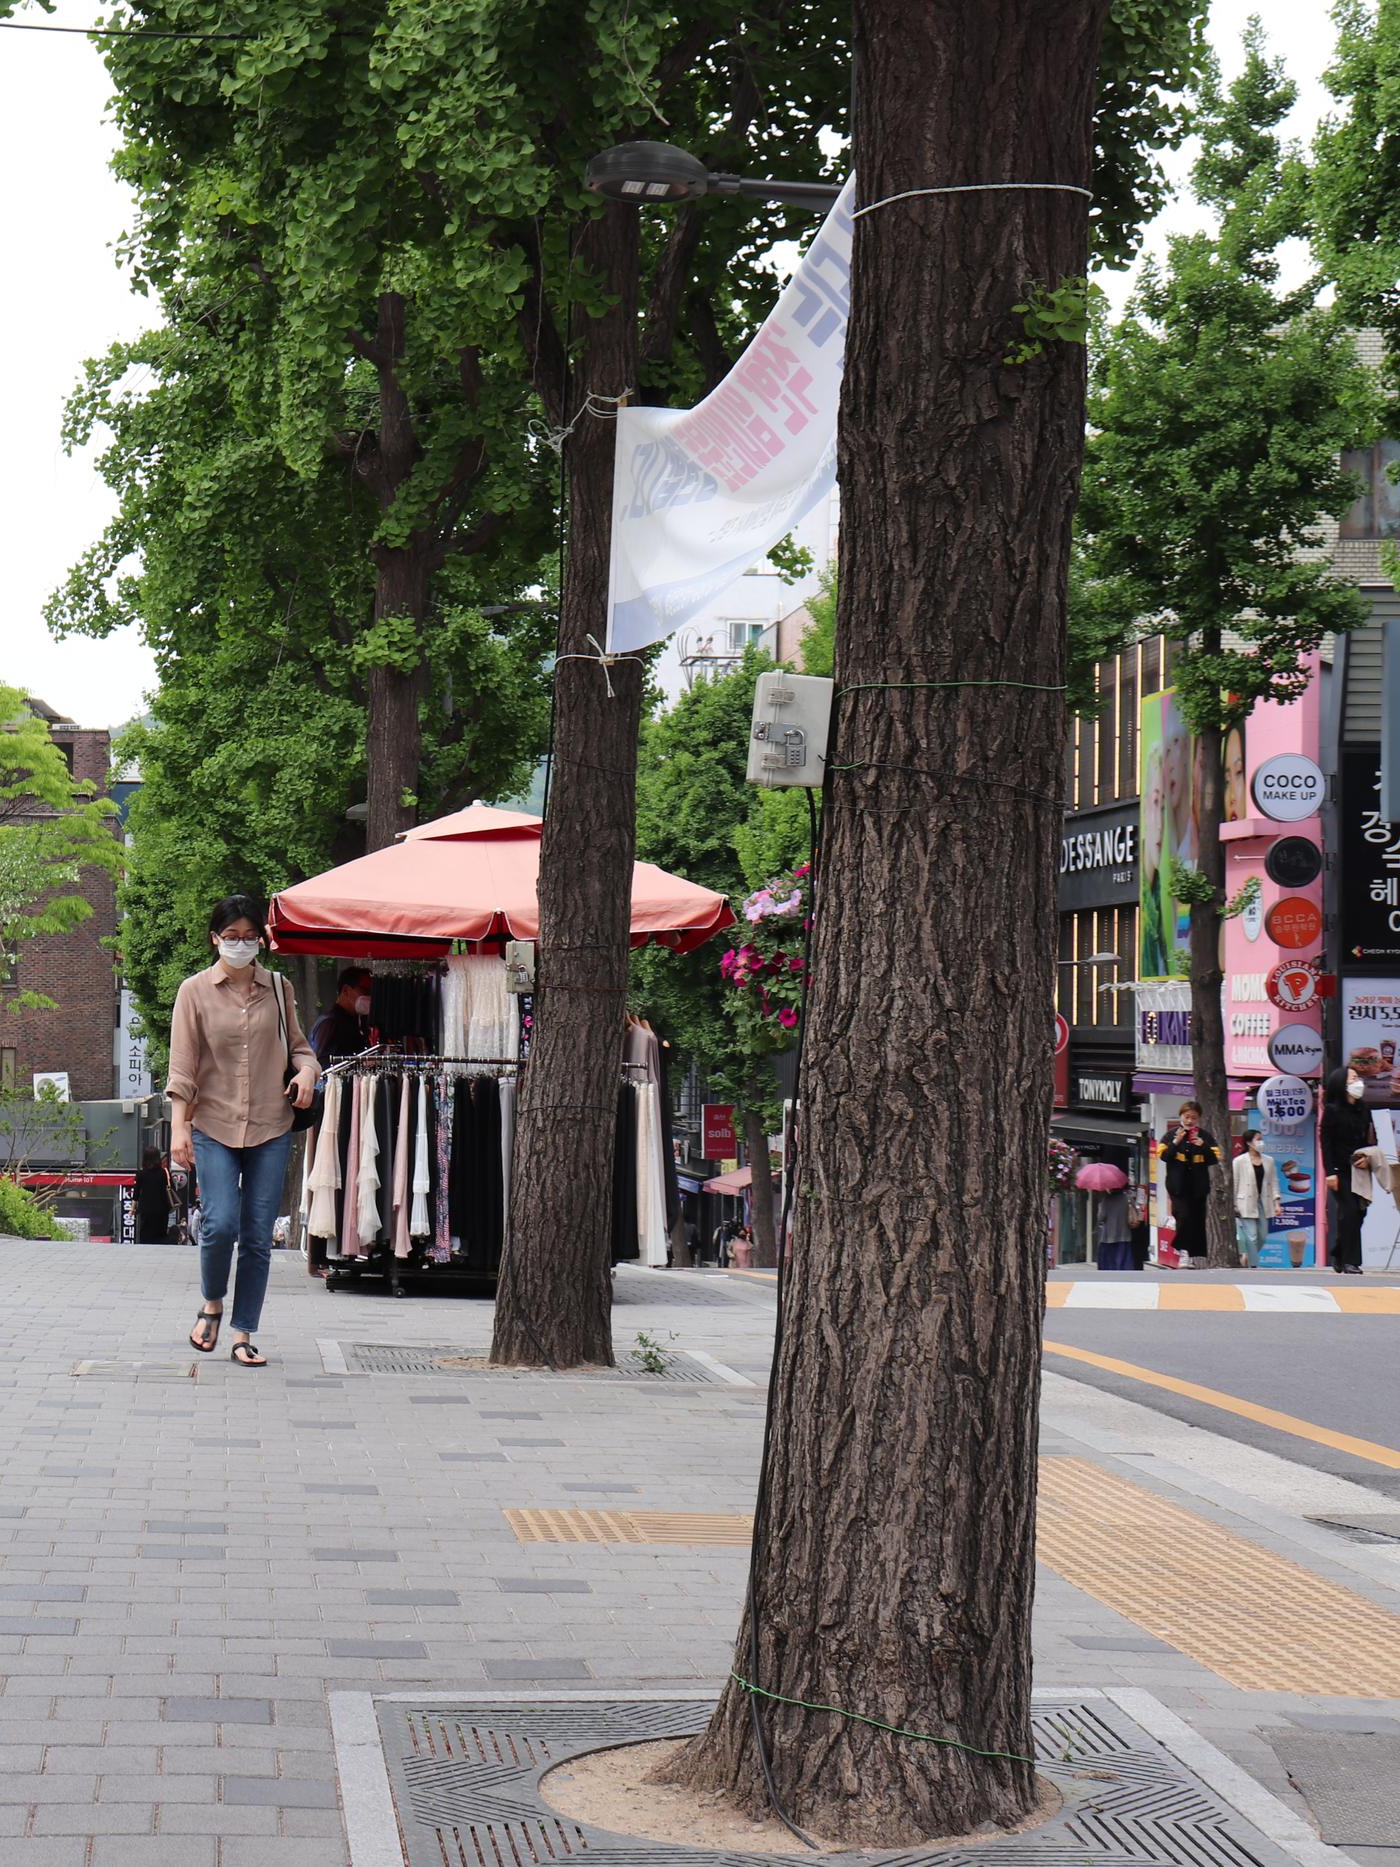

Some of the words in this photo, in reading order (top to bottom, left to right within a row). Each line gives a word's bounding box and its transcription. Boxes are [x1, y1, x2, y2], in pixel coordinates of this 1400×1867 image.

[1263, 774, 1317, 788] COCO
[1262, 791, 1297, 800] MAKE
[1300, 791, 1317, 800] UP
[1060, 825, 1134, 874] DESSANGE
[1271, 961, 1320, 983] LOUISIANA
[1273, 993, 1320, 1011] KITCHEN
[1232, 1012, 1271, 1037] COFFEE
[1274, 1044, 1304, 1056] MMA
[1078, 1078, 1123, 1104] TONYMOLY
